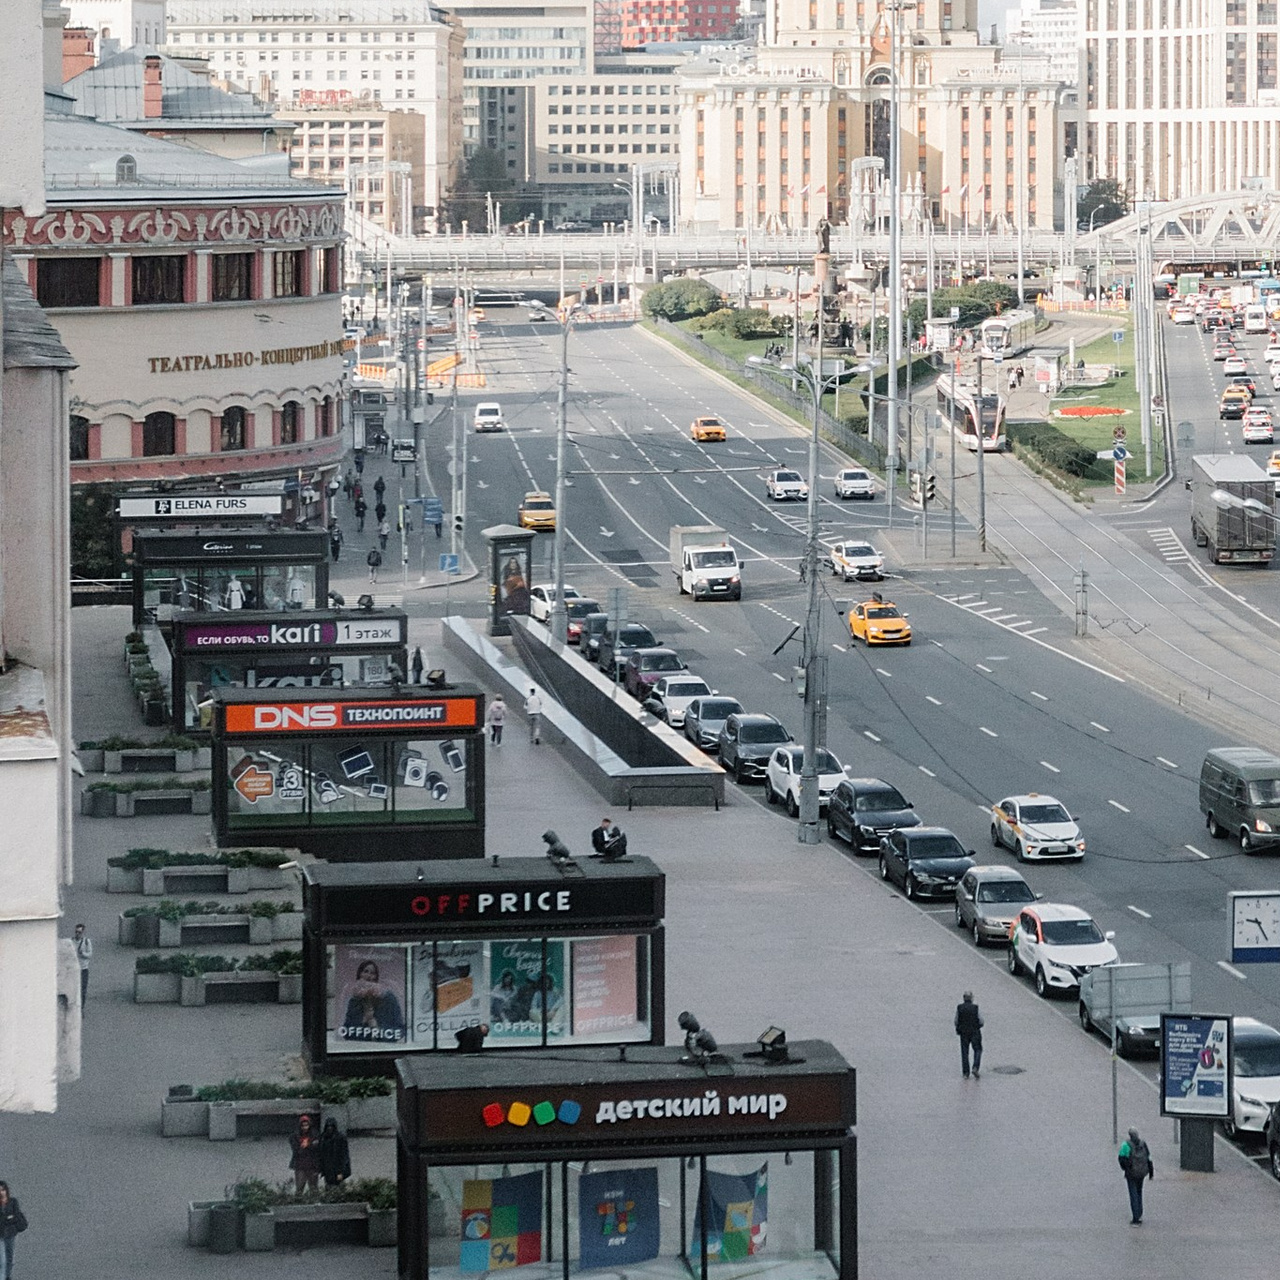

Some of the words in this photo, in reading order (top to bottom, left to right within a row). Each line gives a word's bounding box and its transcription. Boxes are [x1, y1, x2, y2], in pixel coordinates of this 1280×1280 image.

[175, 500, 212, 510] ELENA
[216, 499, 247, 509] FURS
[197, 636, 222, 645] ЕСЛИ
[223, 636, 256, 645] ОБУВЬ,
[256, 635, 269, 644] ТО
[271, 623, 321, 644] kari
[343, 624, 350, 640] 1
[355, 629, 392, 640] этаж
[254, 705, 338, 728] DNS
[346, 706, 443, 722] ТЕХНОПОИНТ
[285, 770, 299, 789] 3
[576, 1013, 635, 1032] OFFPRICE
[338, 1025, 402, 1040] OFFPRICE
[595, 1090, 721, 1123] детский
[728, 1093, 787, 1120] мир
